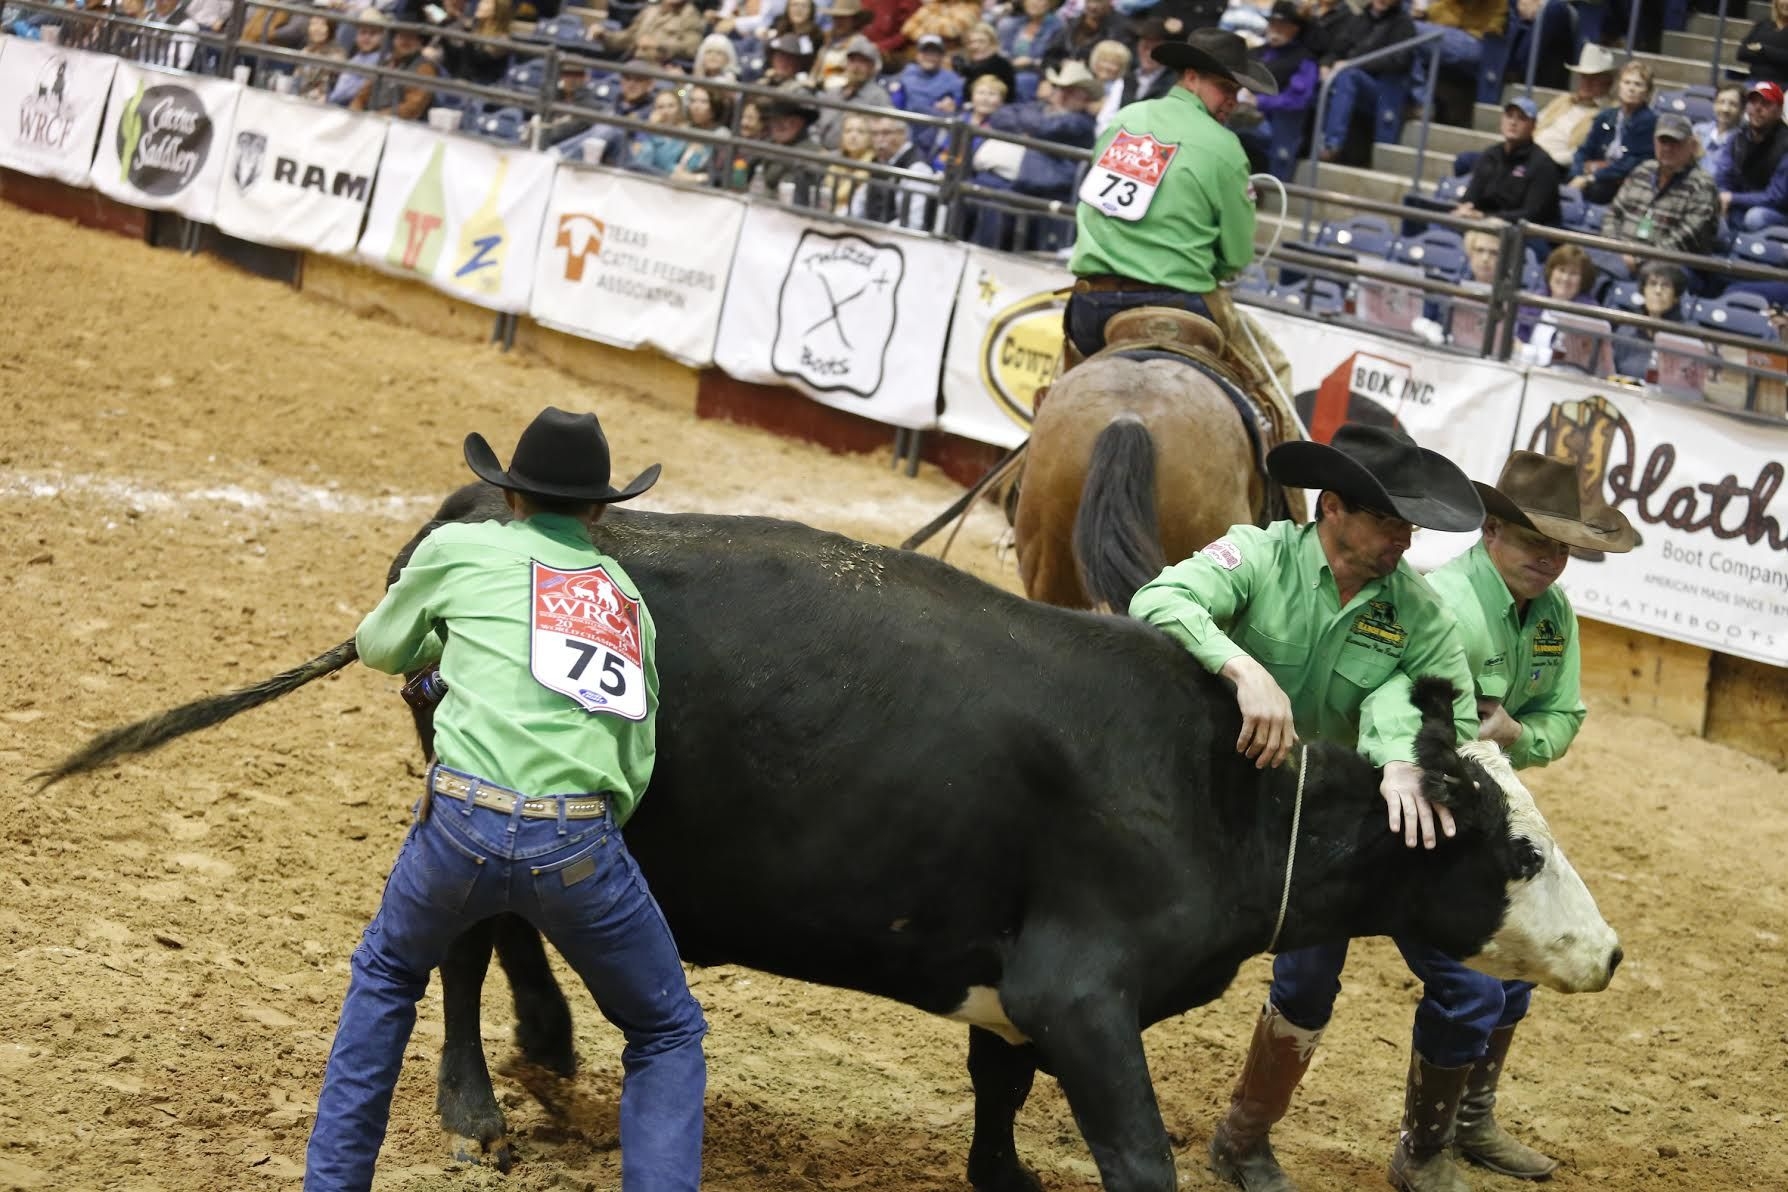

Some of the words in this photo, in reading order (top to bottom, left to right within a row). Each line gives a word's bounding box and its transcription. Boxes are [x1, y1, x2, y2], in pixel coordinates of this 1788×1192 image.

[150, 96, 199, 134] Cactus
[274, 157, 369, 202] RAM
[1109, 147, 1159, 175] WRCA
[1099, 174, 1138, 206] 73
[607, 223, 649, 249] TEXAS
[601, 249, 649, 275] CATTLE
[652, 261, 717, 292] FEEDERS
[596, 274, 687, 309] ASSOCIATION
[1355, 368, 1394, 395] BOX
[1402, 381, 1435, 406] INC
[1663, 540, 1703, 568] Boot
[1709, 551, 1788, 594] Company
[1644, 573, 1699, 597] AMERICAN
[1700, 586, 1731, 605] MADE
[1733, 594, 1765, 614] SINCE
[540, 594, 637, 648] WRCA
[566, 638, 626, 697] 75
